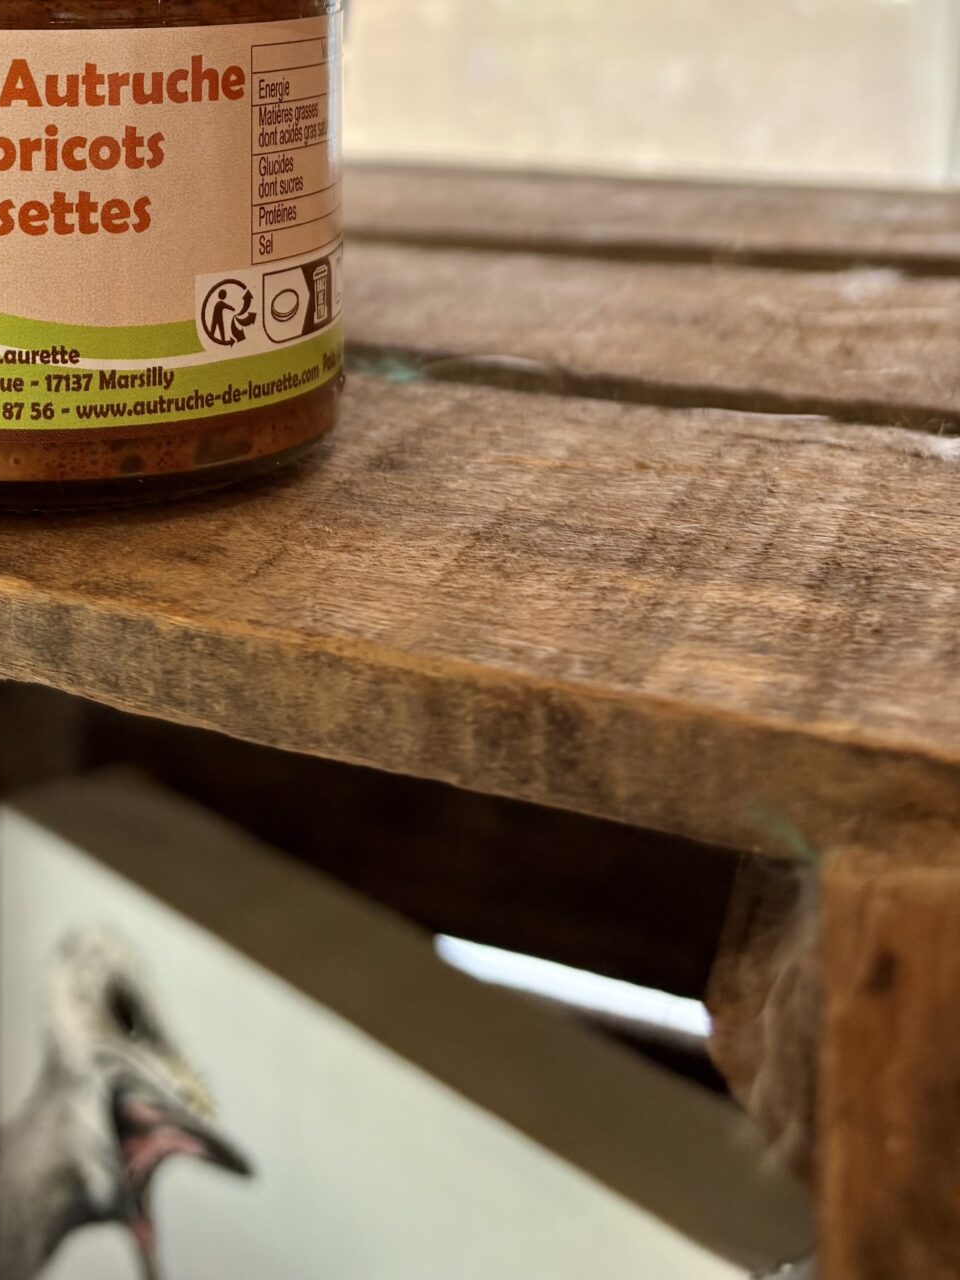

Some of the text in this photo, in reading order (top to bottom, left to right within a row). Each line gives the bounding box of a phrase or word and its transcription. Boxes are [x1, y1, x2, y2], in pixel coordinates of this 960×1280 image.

[259, 76, 290, 102] Energie
[259, 103, 319, 127] Matières grasses
[258, 127, 278, 148] dont
[280, 123, 303, 145] acides
[304, 122, 317, 146] gras
[258, 153, 294, 177] Glucides
[258, 176, 304, 199] dont sucres
[259, 204, 297, 227] Protéines
[259, 233, 273, 255] Sel
[44, 373, 94, 393] 17137
[99, 365, 175, 391] Marsilly
[2, 401, 25, 421] 87
[30, 401, 55, 421] 56
[76, 364, 320, 420] www.autruche-de-laurette.com
